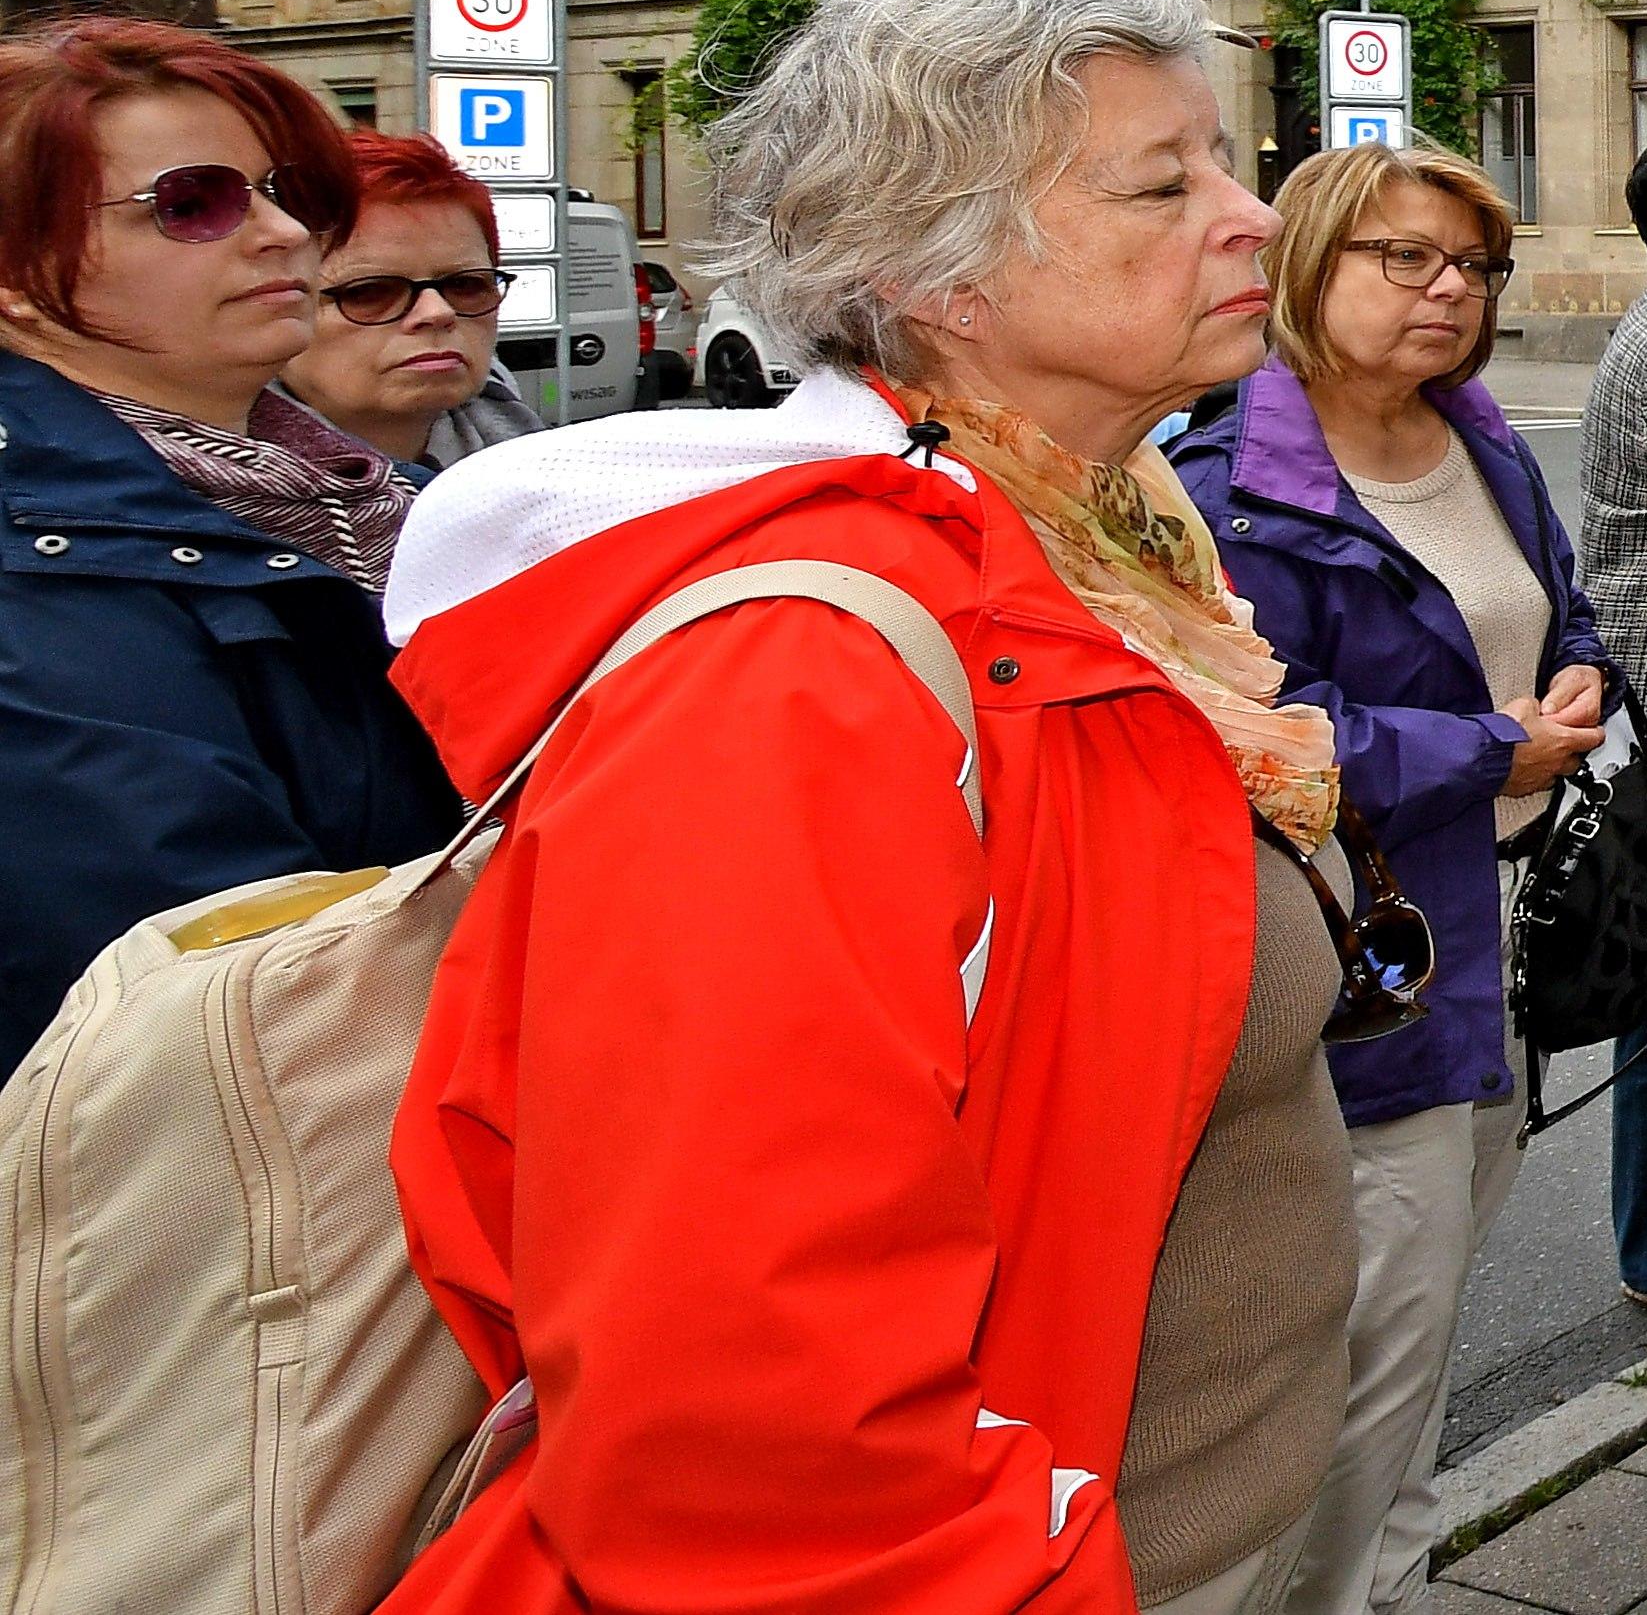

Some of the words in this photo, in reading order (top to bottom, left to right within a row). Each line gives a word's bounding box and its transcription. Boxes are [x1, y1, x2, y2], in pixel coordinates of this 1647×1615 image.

[466, 36, 520, 54] ZONE
[1354, 42, 1379, 64] 30
[1351, 80, 1383, 91] ZONE
[472, 95, 513, 141] P
[466, 155, 521, 171] ZONE
